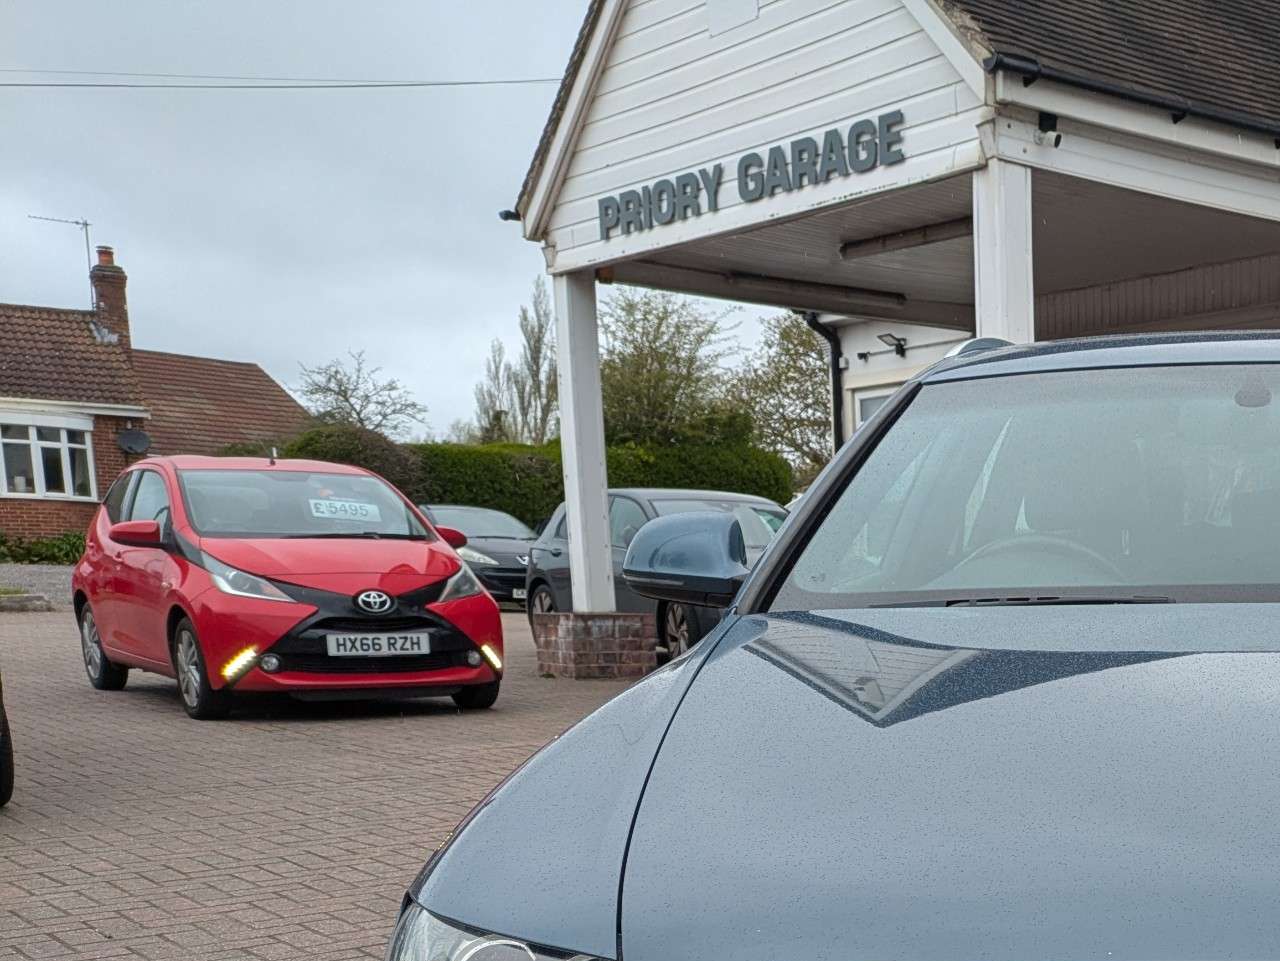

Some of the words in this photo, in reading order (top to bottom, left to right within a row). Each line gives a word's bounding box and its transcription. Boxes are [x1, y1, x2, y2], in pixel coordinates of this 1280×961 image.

[598, 162, 724, 241] PRIORY
[737, 109, 906, 202] GARAGE
[336, 637, 383, 652] HX66
[387, 636, 421, 651] RZH
